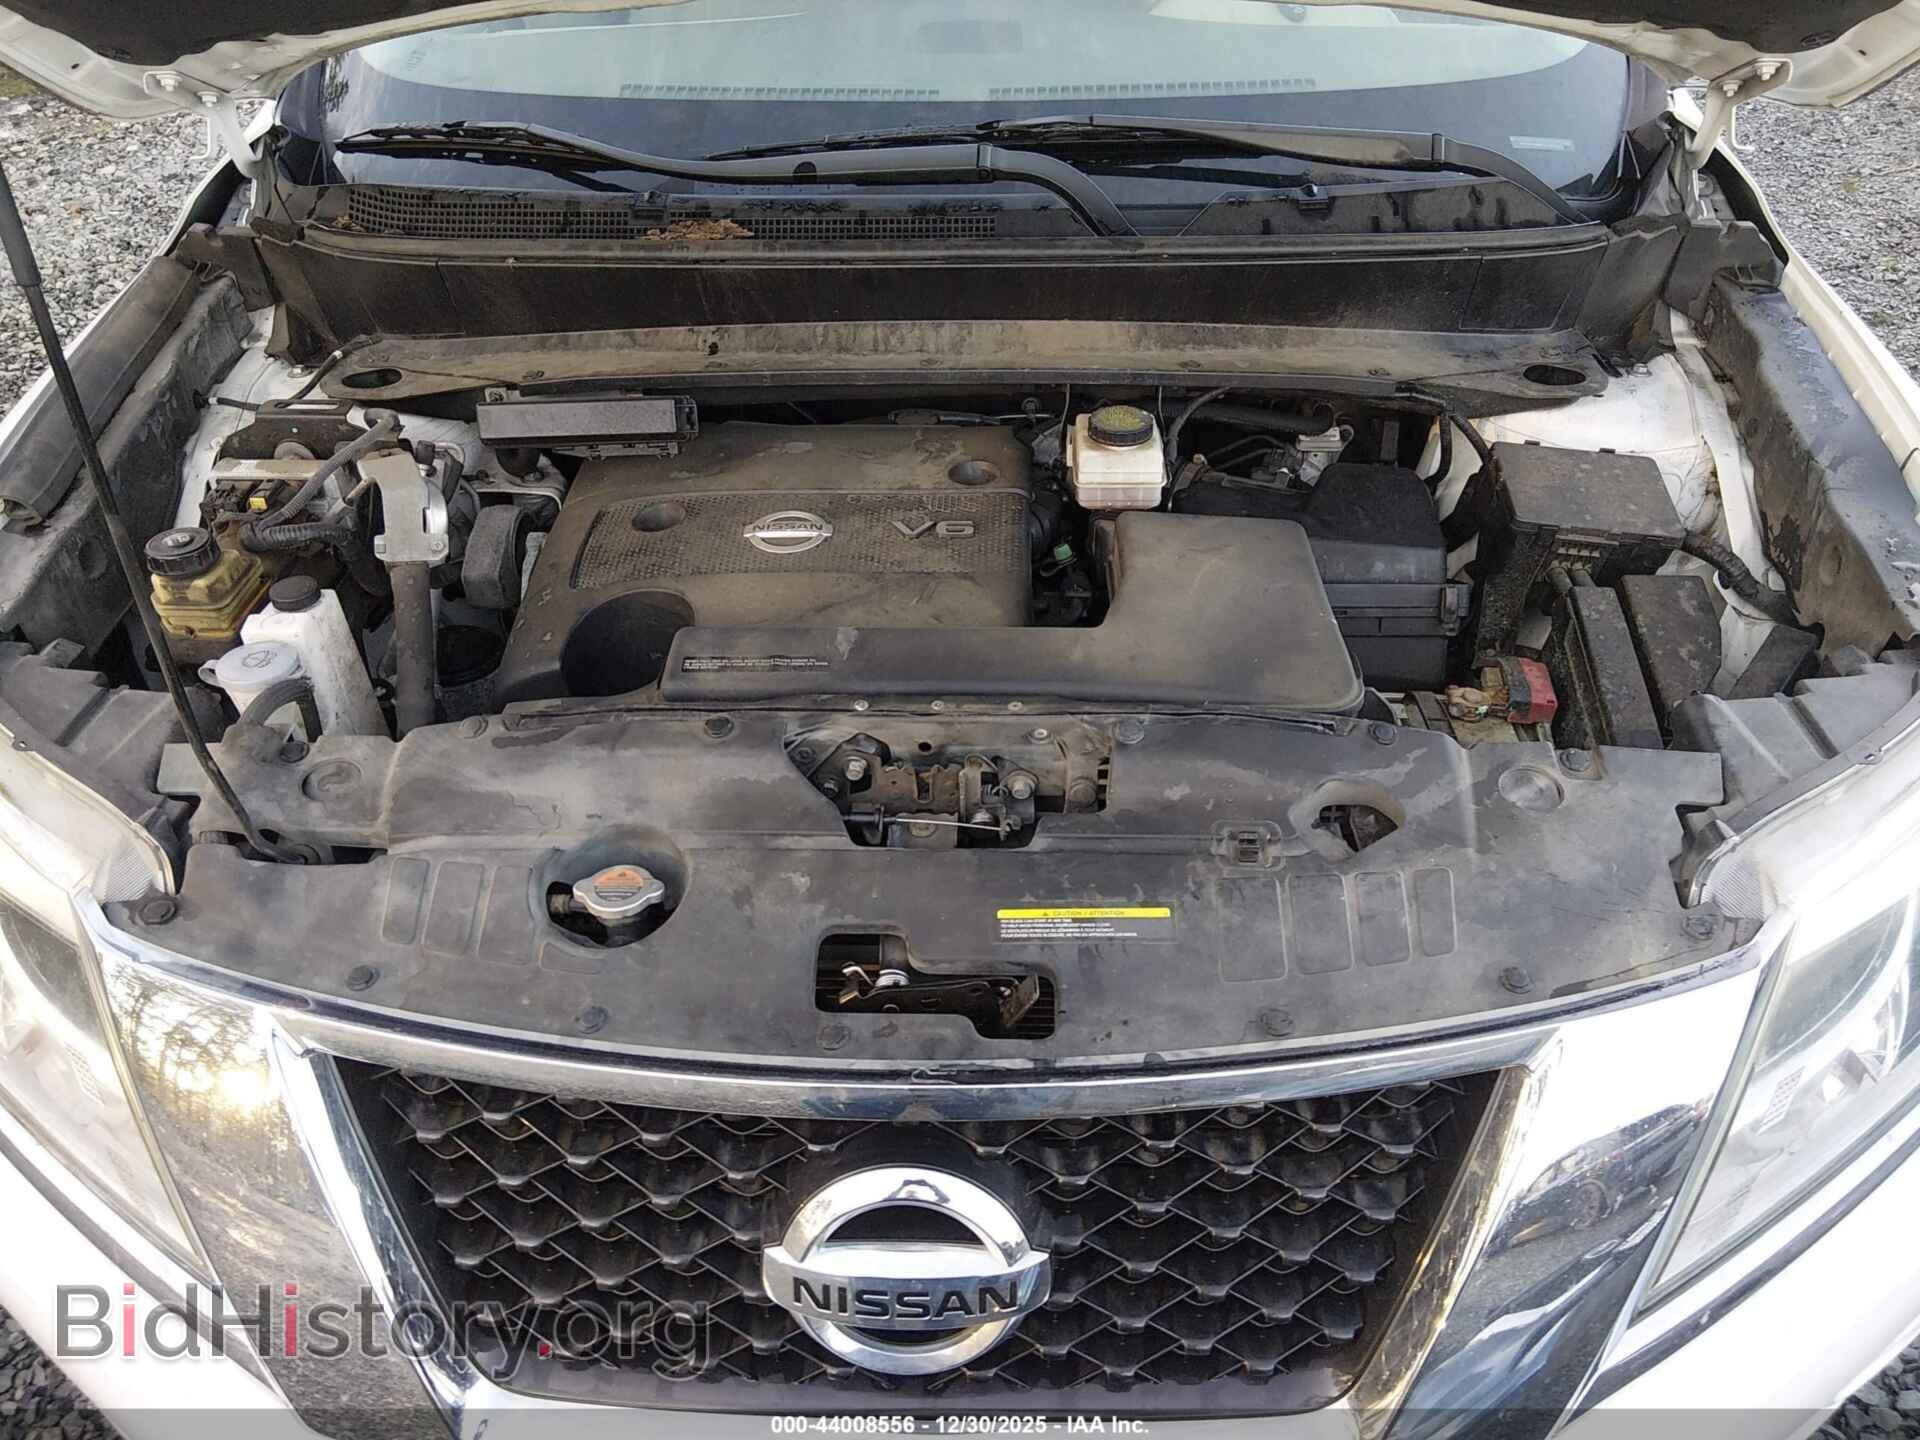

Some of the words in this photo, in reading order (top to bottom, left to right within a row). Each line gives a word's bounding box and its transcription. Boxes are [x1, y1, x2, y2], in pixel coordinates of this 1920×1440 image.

[752, 522, 824, 532] NISSAN
[891, 520, 976, 538] V6
[793, 1277, 1020, 1321] NISSAN
